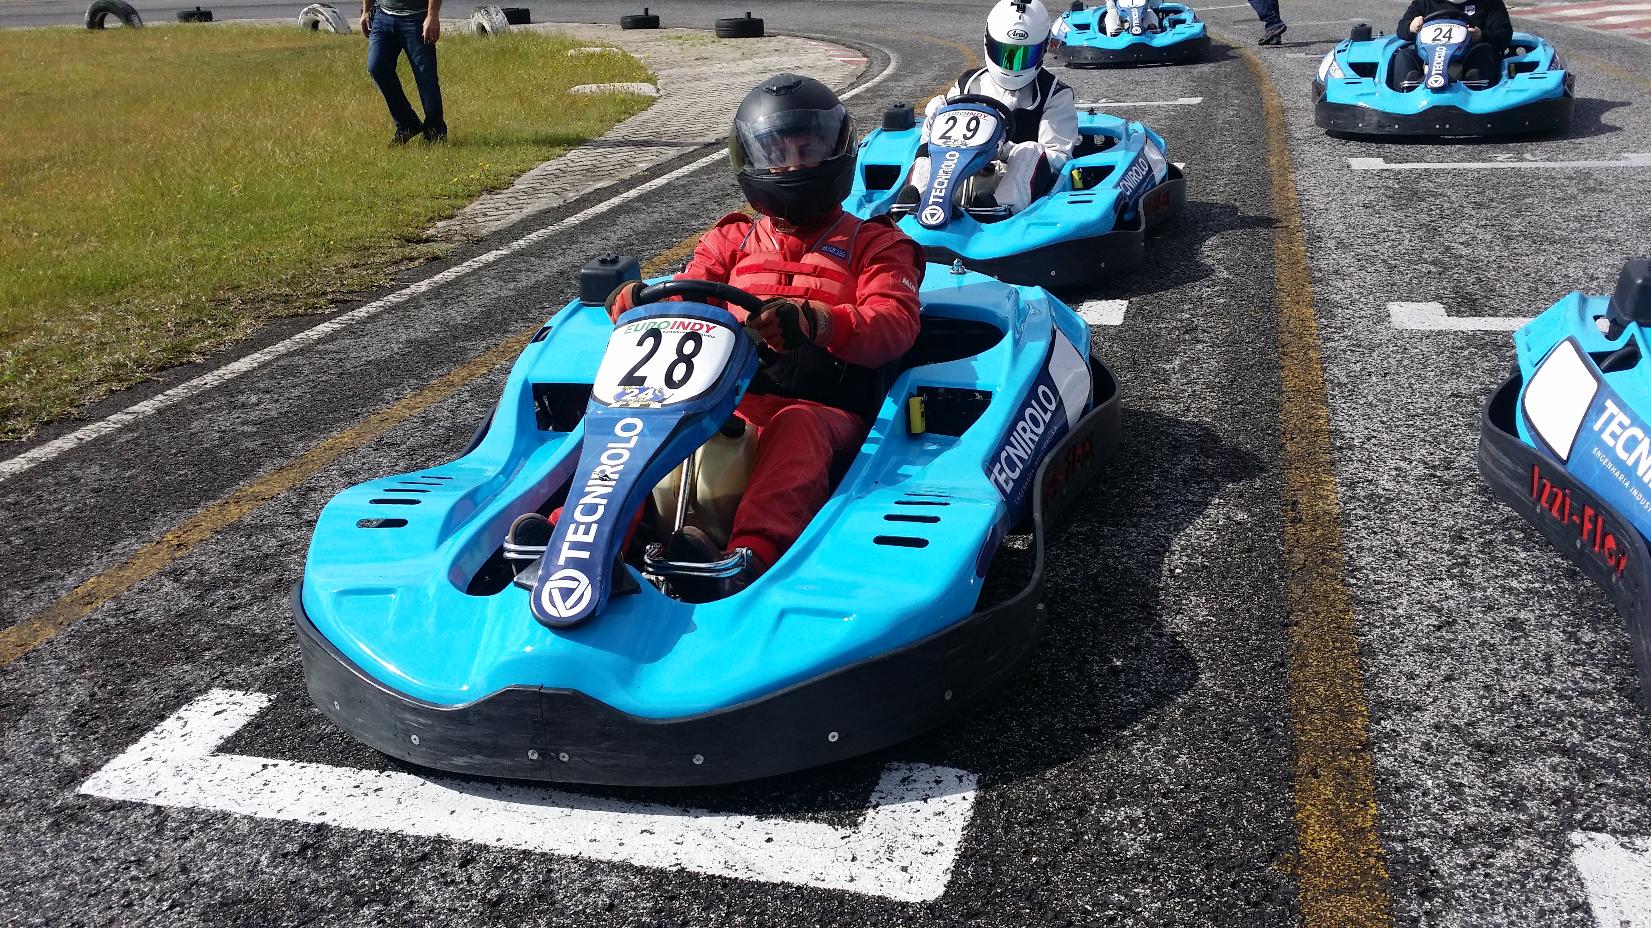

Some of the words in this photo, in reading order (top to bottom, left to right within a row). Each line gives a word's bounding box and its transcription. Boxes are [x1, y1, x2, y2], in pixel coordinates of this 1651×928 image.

[1432, 28, 1453, 42] 24
[939, 116, 980, 140] 29
[929, 151, 960, 205] TECNIROLO
[624, 320, 718, 335] EUROINDY
[617, 327, 703, 390] 28
[1593, 447, 1630, 489] ENGENHARIA
[558, 417, 644, 565] TECNIROLO
